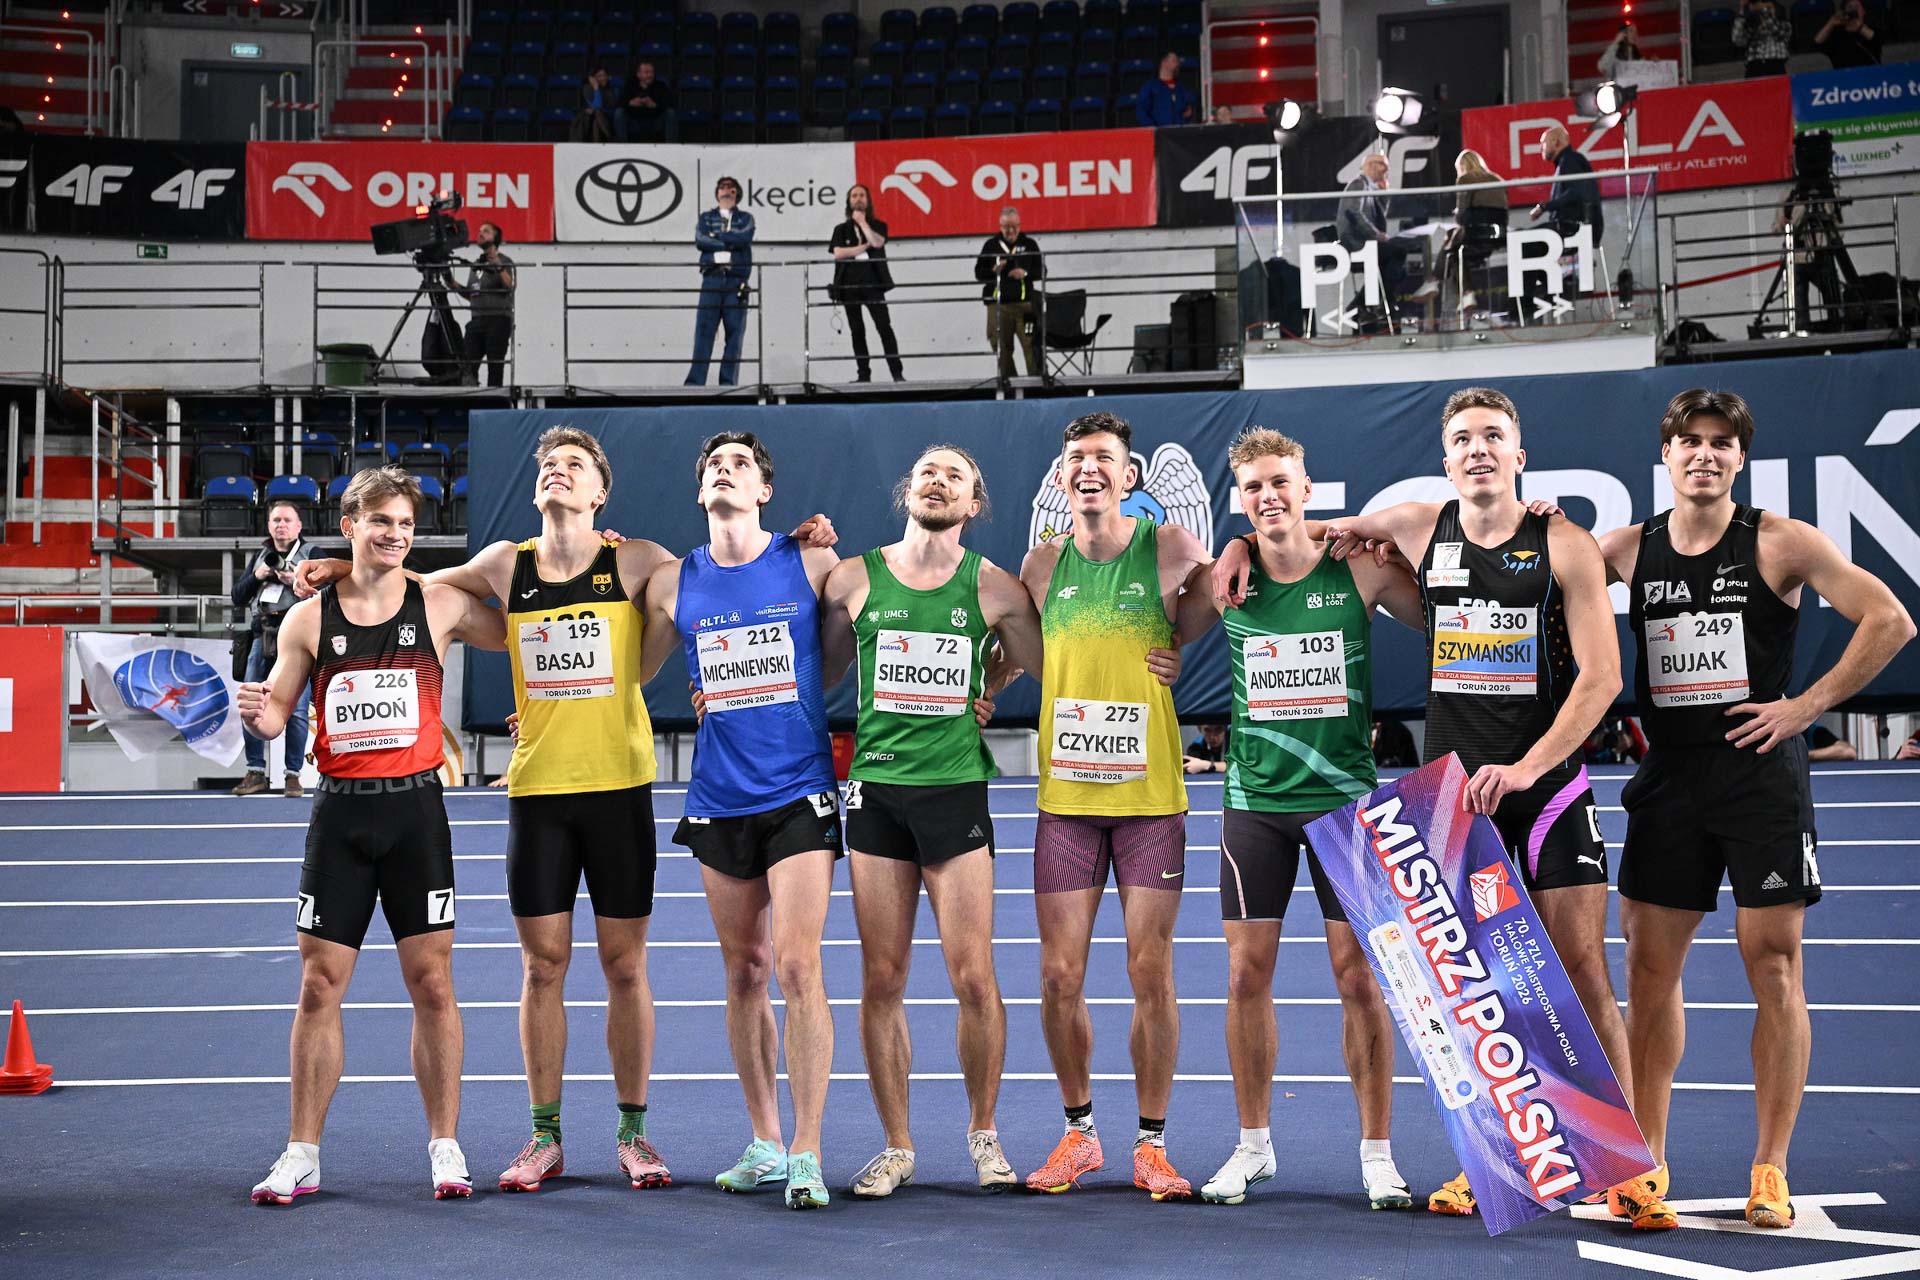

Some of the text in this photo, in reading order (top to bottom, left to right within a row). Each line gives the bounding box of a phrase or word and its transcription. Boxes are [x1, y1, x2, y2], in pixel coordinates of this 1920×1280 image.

[1811, 79, 1920, 106] Zdrowie t
[1509, 100, 1745, 170] PZLA
[1685, 155, 1748, 170] ATLETYKI
[1850, 150, 1891, 162] LUXMED
[971, 158, 1132, 201] ORLEN
[1180, 143, 1282, 199] 4F
[45, 163, 134, 206] 4F
[150, 168, 236, 210] 4F
[742, 178, 836, 214] kęcie
[1507, 222, 1594, 298] R1
[1299, 239, 1379, 309] P1
[1501, 552, 1541, 576] Sopot
[1058, 585, 1078, 599] 4F
[1727, 580, 1749, 588] OPOLE
[1714, 594, 1748, 603] OPOLSKIE
[700, 614, 727, 628] RLTL
[755, 604, 799, 616] visitRadom.pl
[884, 609, 909, 618] UMCS
[1490, 612, 1528, 630] 330
[568, 622, 600, 639] 195
[747, 626, 782, 646] 212
[1694, 618, 1733, 637] 249
[936, 638, 958, 654] 72
[1247, 636, 1335, 659] polanik 103
[1438, 640, 1531, 663] SZYMAŃSKI
[536, 651, 594, 672] BASAJ
[704, 654, 790, 683] MICHNIEWSKI
[1661, 650, 1728, 674] BUJAK
[374, 673, 408, 689] 226
[878, 664, 966, 686] SIEROCKI
[1250, 666, 1342, 690] ANDRZEJCZAK
[544, 688, 592, 696] TORUŃ 2026
[1457, 682, 1510, 692] TORUŃ 2026
[1670, 693, 1698, 703] TORUŃ
[336, 697, 407, 723] BYDOŃ
[726, 694, 775, 707] TORUŃ 2026
[894, 702, 922, 711] TORUŃ
[1056, 706, 1140, 722] polanik 275
[1271, 707, 1324, 717] TORUŃ 2026
[348, 738, 399, 749] TORUŃ 2026
[1058, 732, 1140, 754] CZYKIER
[316, 769, 437, 795] MOUR
[1072, 771, 1100, 779] TORUŃ
[1761, 882, 1789, 890] adidas
[298, 895, 308, 923] 7
[435, 892, 450, 921] 7
[1514, 916, 1546, 971] 70. PZLA
[1489, 928, 1533, 1005] TORUŃ 2026
[1358, 797, 1581, 1203] MISTRZ POLSKI
[1503, 922, 1579, 1067] HALOWE MISTRZOSTWA POLSKI
[1427, 1016, 1446, 1039] 4F
